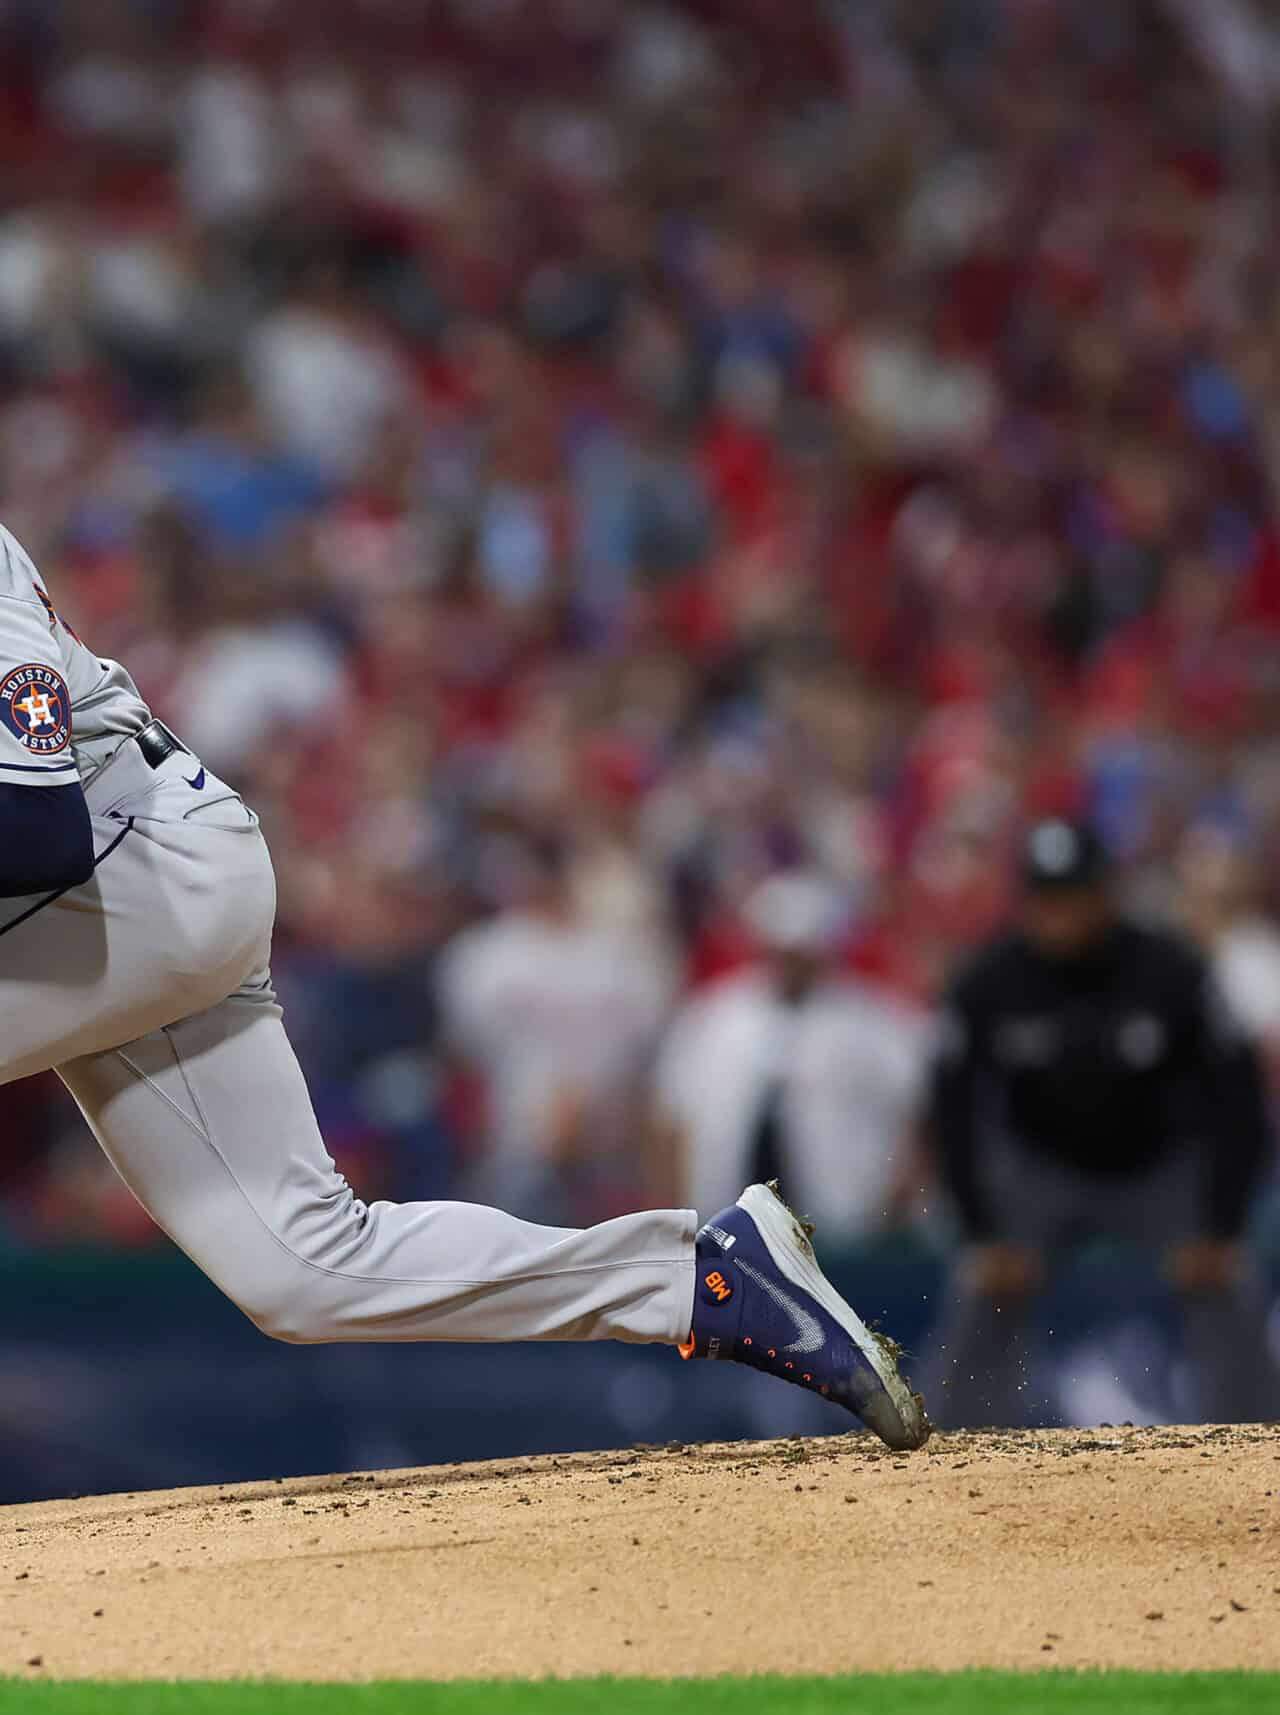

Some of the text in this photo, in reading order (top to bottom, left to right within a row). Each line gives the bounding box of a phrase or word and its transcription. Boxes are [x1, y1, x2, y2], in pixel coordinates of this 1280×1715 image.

[1, 669, 61, 700] HOUSTON
[21, 693, 55, 728] H
[18, 725, 68, 750] ASTROS
